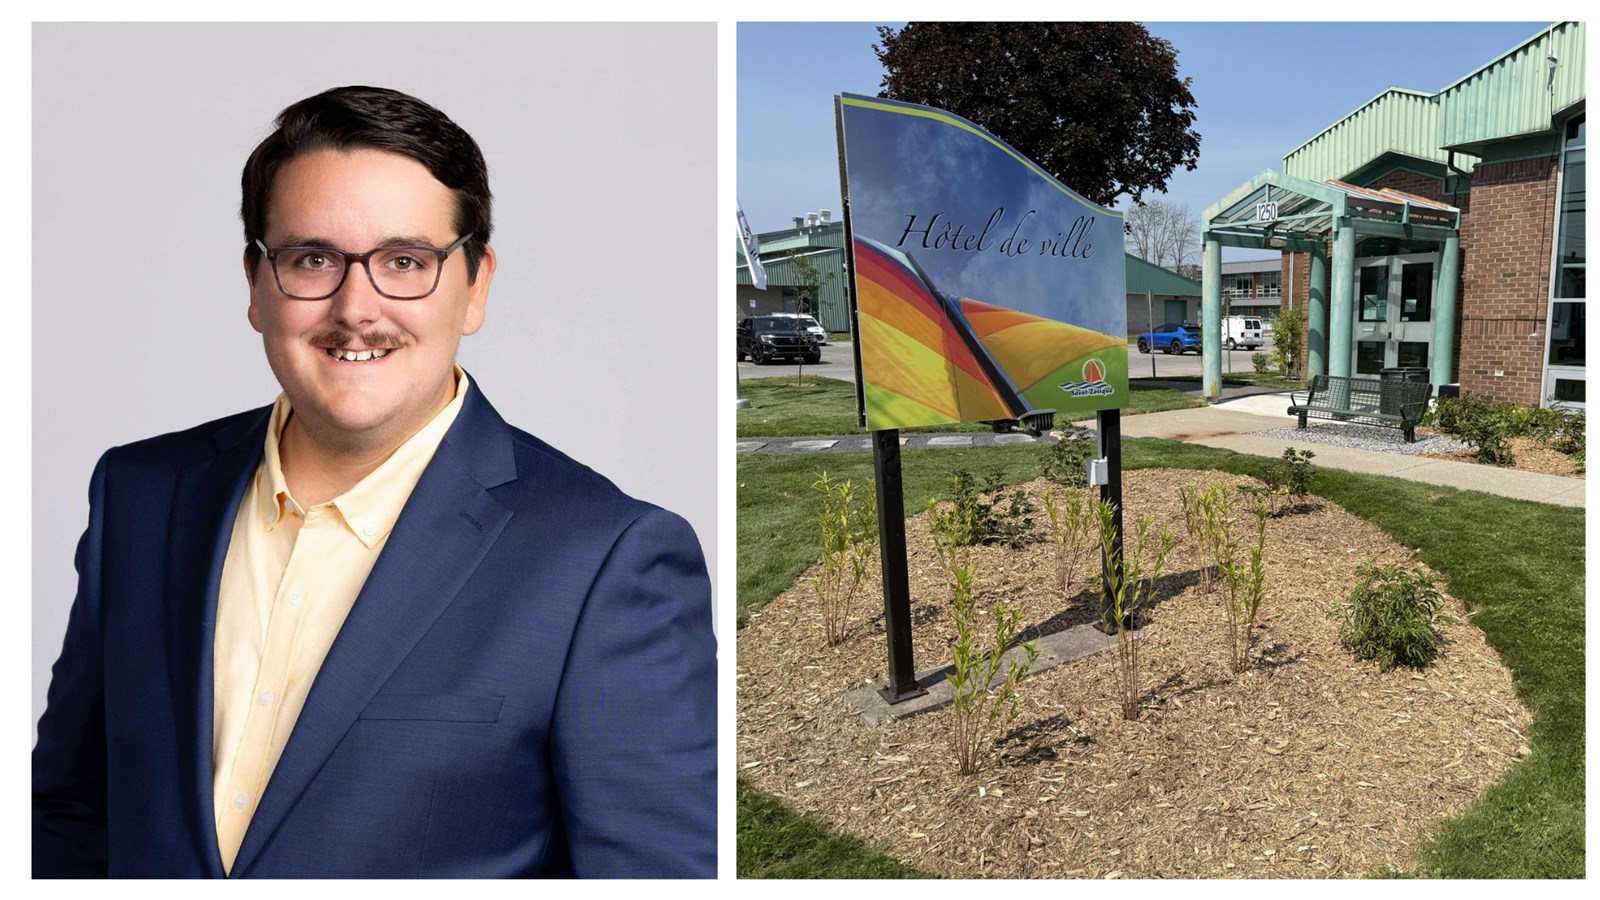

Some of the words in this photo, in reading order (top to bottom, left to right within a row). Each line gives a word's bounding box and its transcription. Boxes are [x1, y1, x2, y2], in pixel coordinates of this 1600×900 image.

[1258, 203, 1276, 221] 1250
[897, 207, 1004, 251] Hôtel
[1000, 209, 1036, 257] de
[1040, 215, 1095, 259] ville
